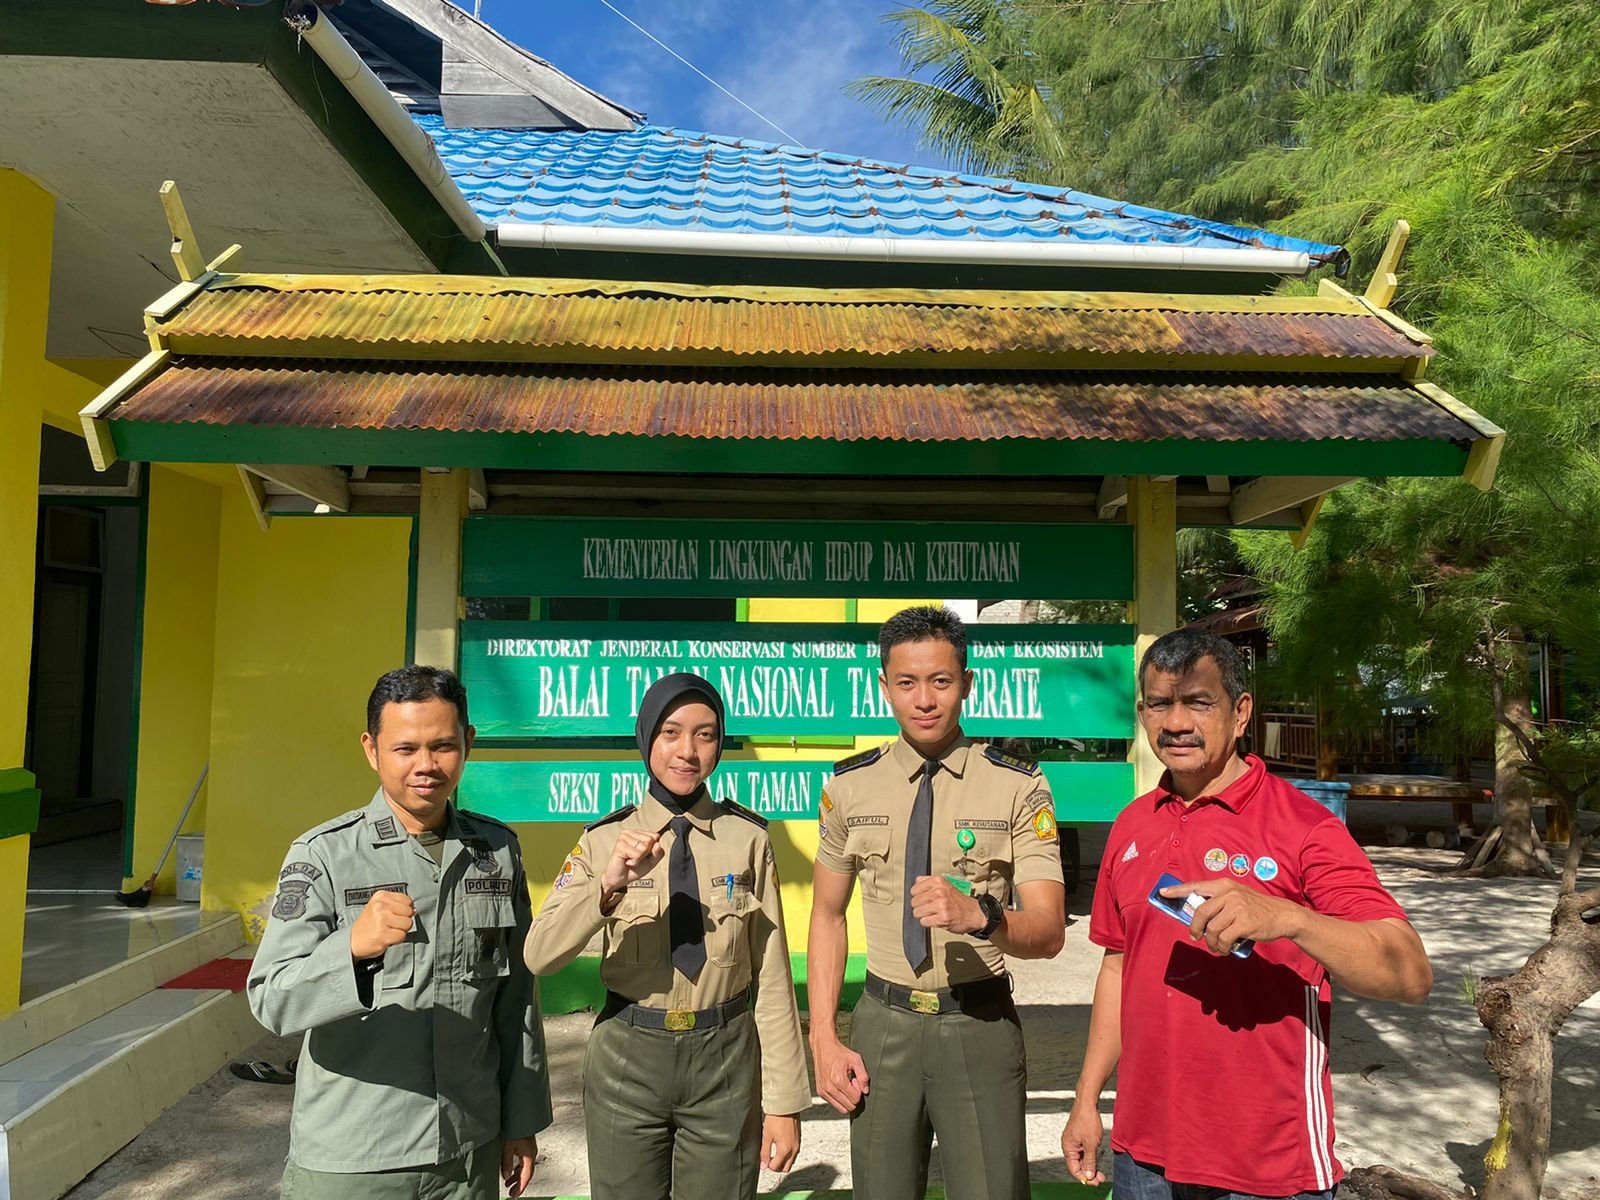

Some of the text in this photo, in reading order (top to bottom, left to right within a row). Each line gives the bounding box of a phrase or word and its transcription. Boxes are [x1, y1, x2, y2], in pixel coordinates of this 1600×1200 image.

[583, 538, 1020, 582] KEMENTERIAN LINGKUNGAN HIDUP DAN KEHUTANAN
[487, 639, 592, 658] DIREKTORAT
[600, 640, 683, 658] JENDERAL
[688, 640, 785, 658] KONSERVASI
[792, 641, 857, 658] SUMBER
[973, 640, 1005, 659] DAN
[1013, 640, 1104, 659] EKOSISTEM
[538, 665, 610, 717] BALAI
[720, 666, 834, 718] NASIONAL
[548, 772, 600, 814] SEKSI
[748, 771, 811, 812] TAMAN
